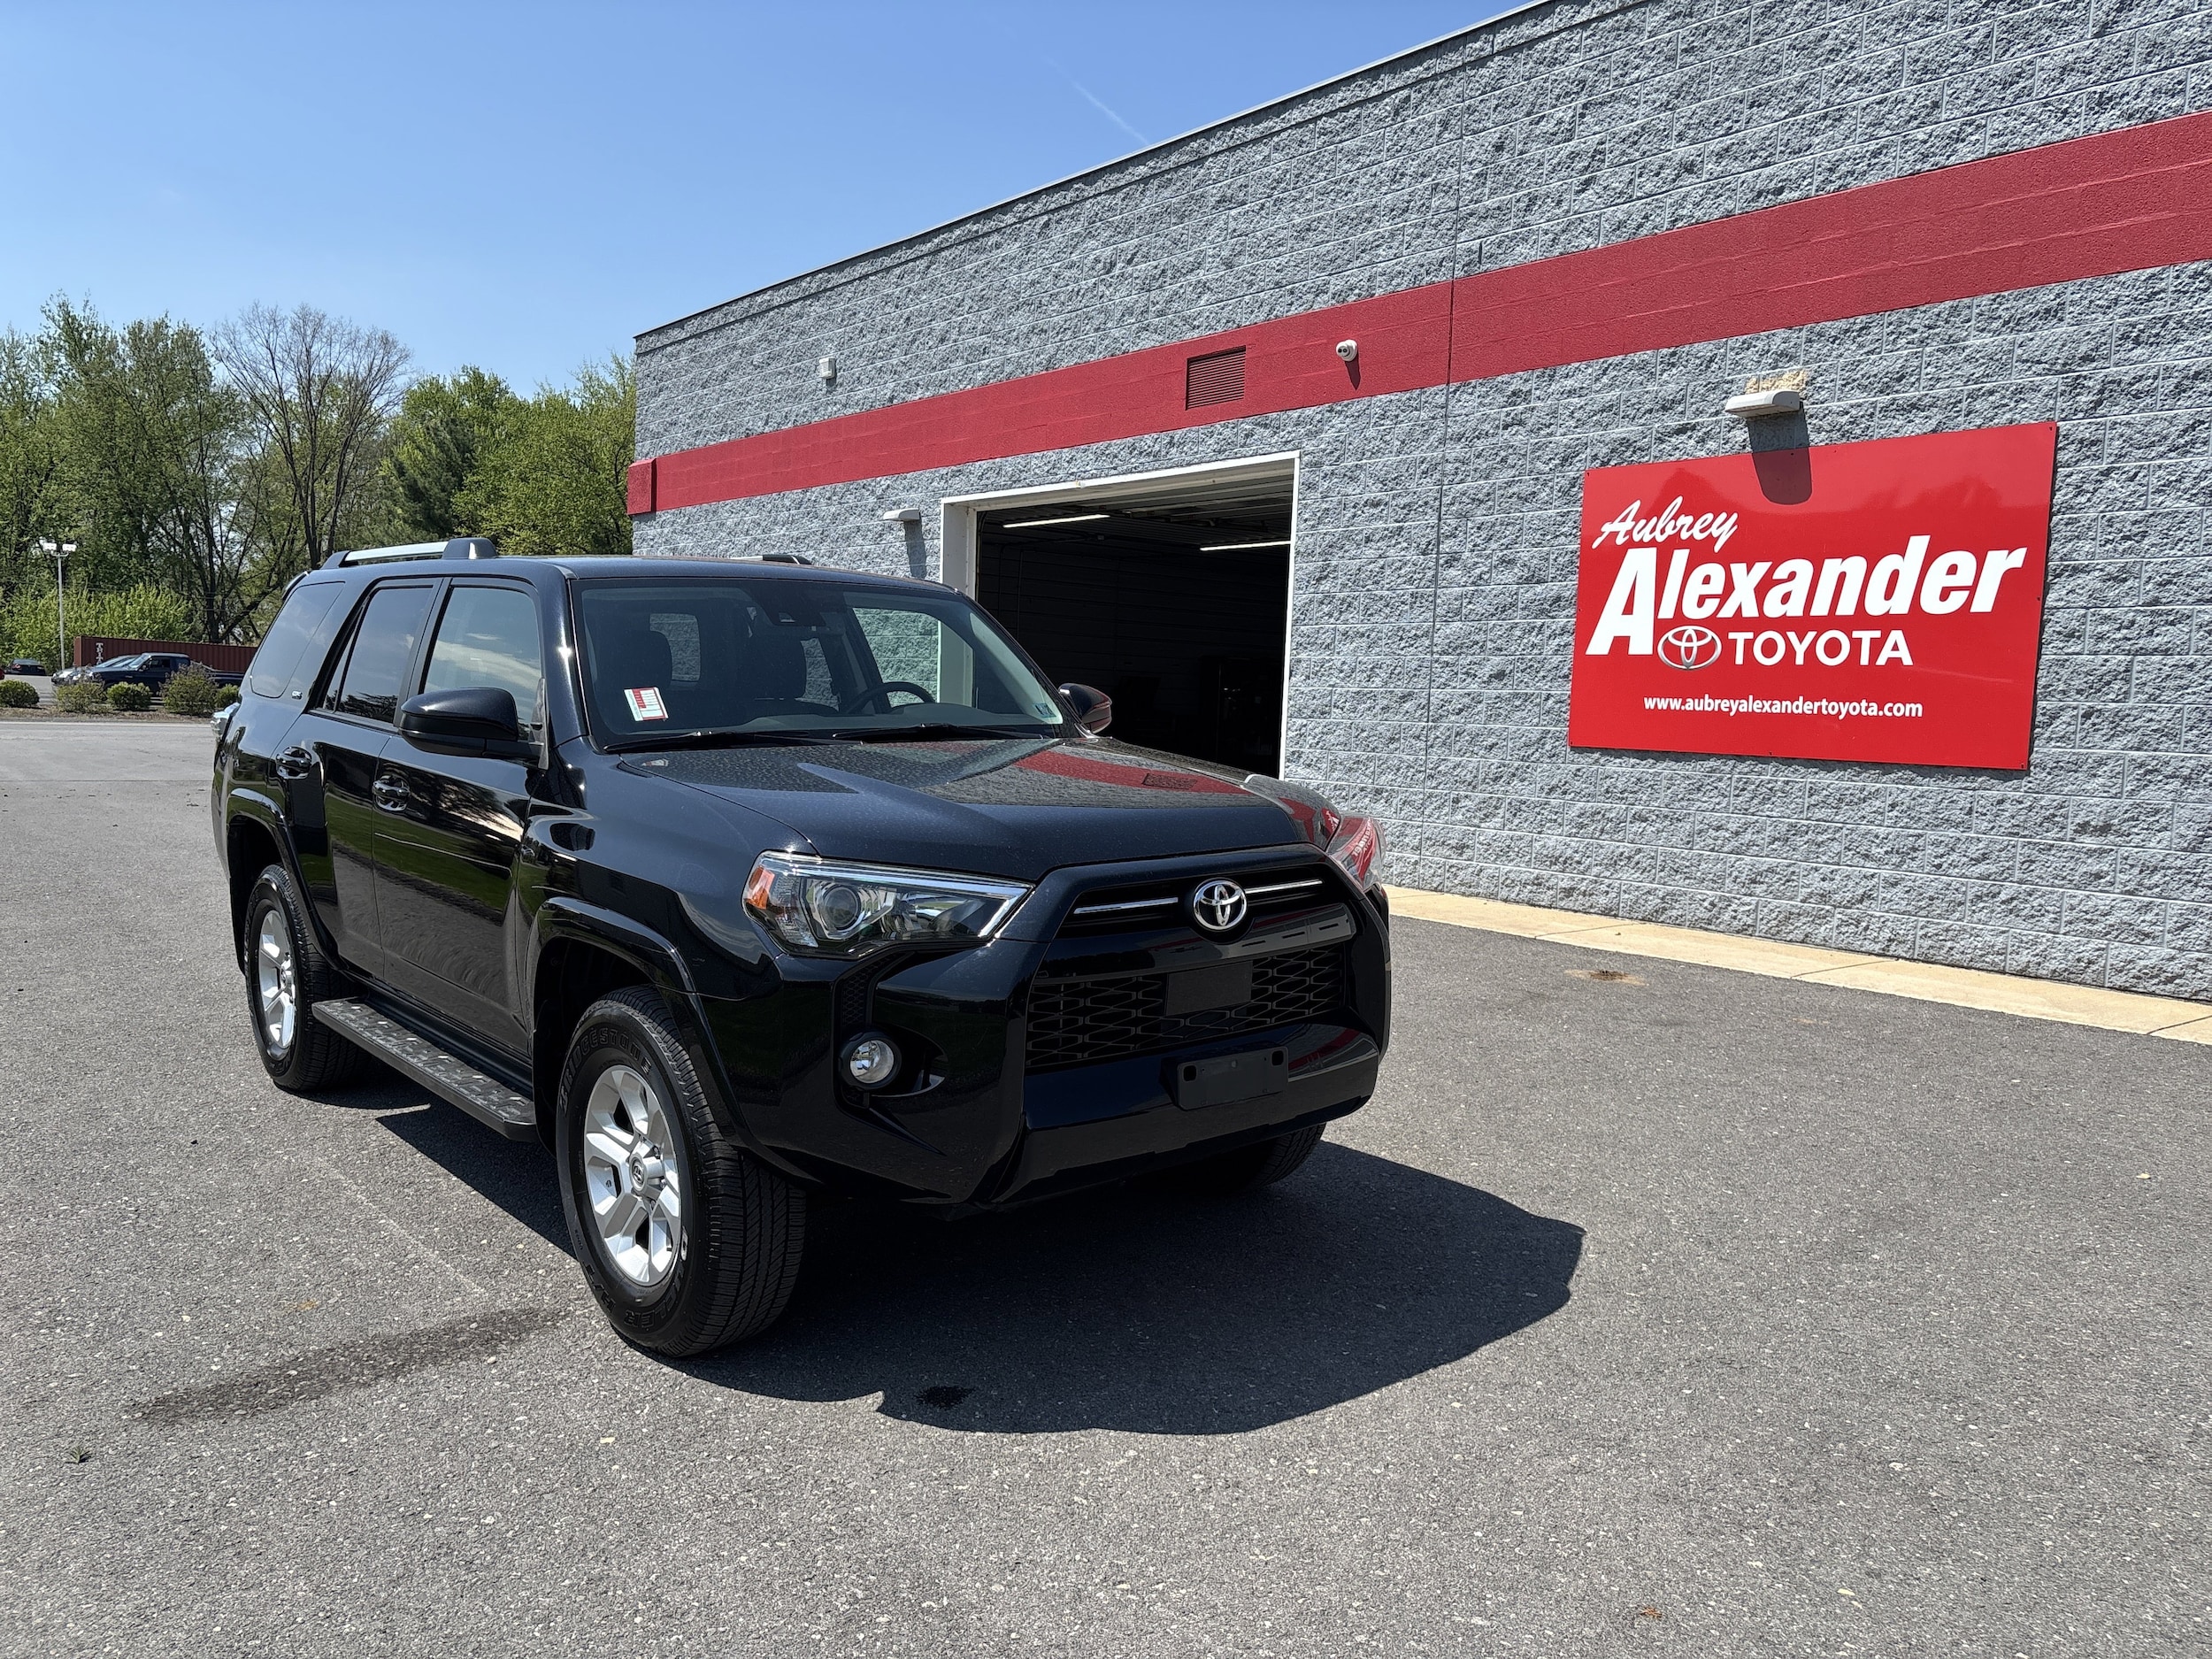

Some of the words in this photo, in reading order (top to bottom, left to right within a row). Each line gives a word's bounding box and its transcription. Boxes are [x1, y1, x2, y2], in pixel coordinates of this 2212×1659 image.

[1591, 495, 1739, 553] Aubrey
[1585, 534, 2028, 656] Alexander
[1727, 629, 1914, 666] TOYOTA
[1643, 694, 1924, 720] www.aubreyalexandertoyota.com
